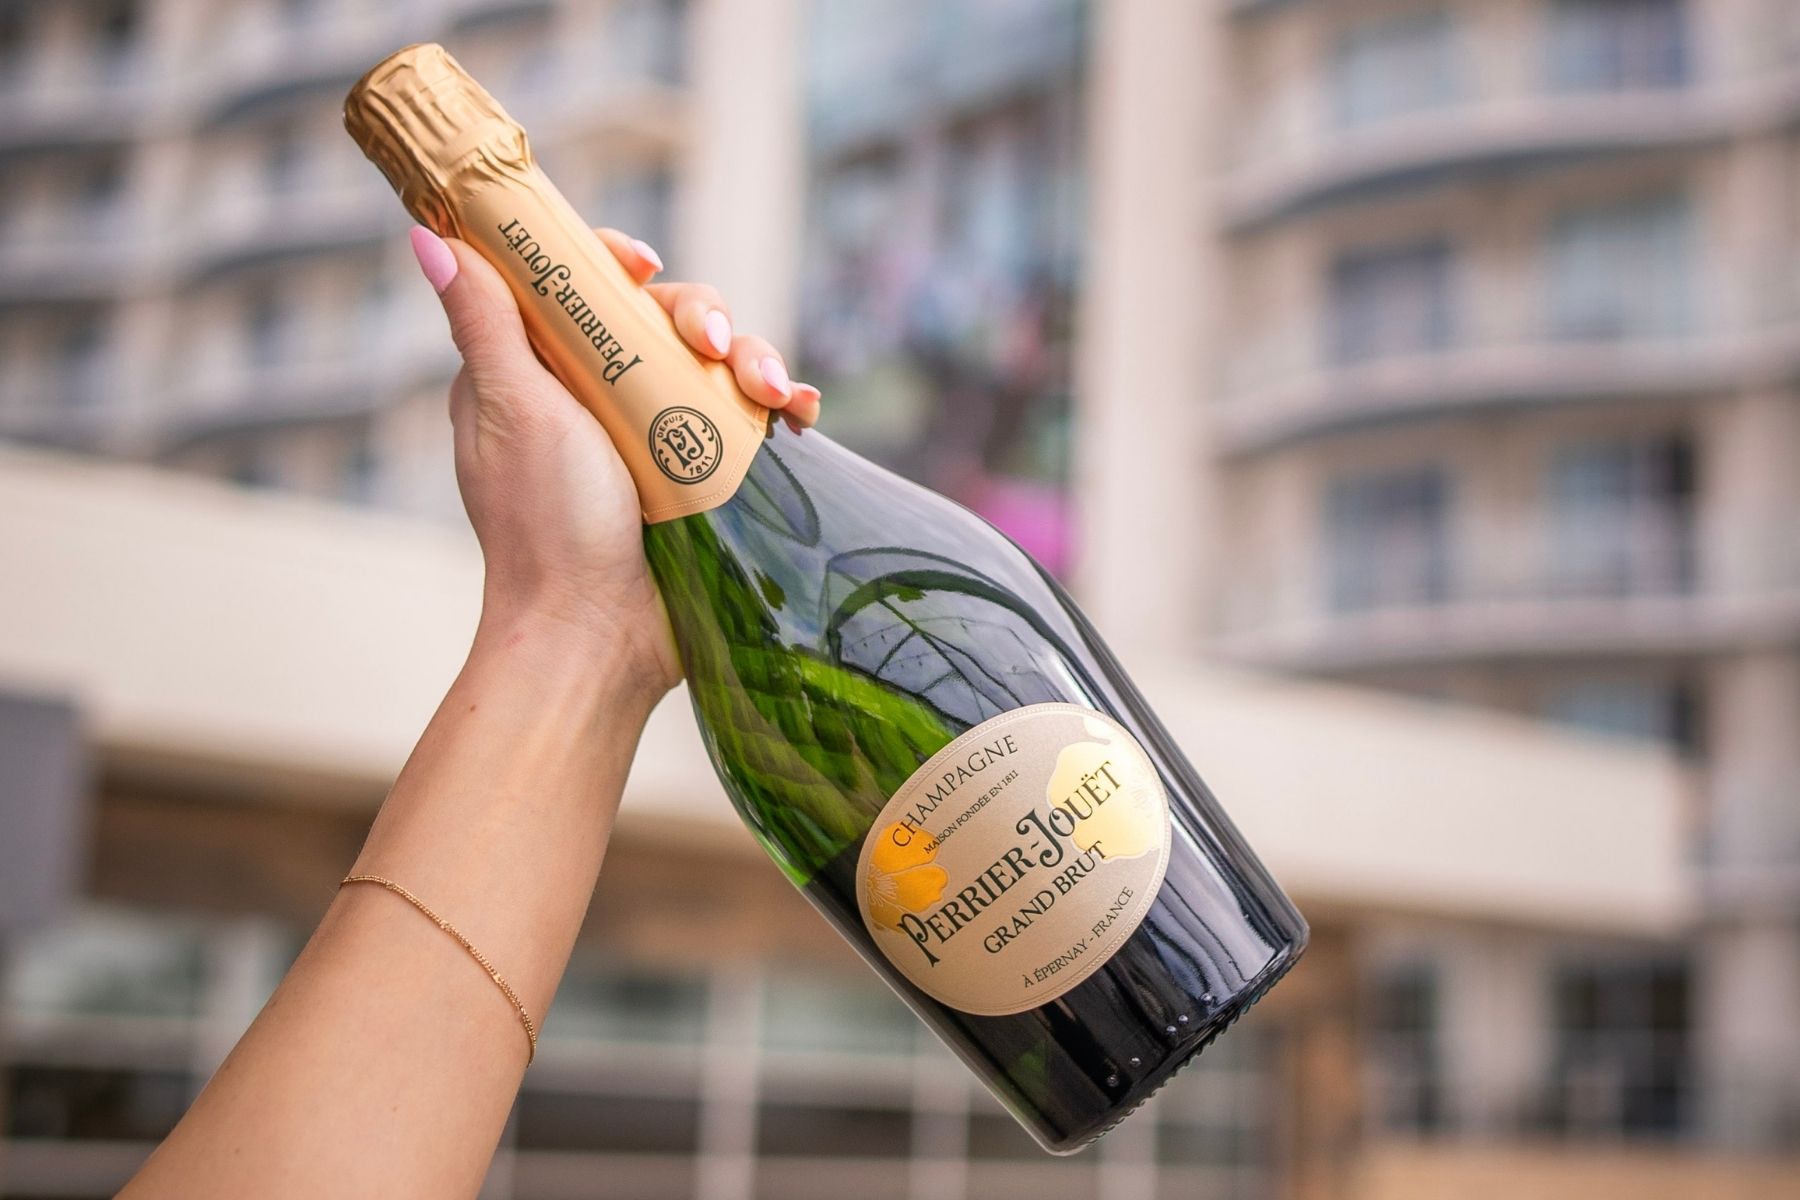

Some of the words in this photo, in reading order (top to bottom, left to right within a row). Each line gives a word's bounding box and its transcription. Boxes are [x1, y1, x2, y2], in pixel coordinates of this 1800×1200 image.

[657, 414, 684, 438] DEPUIS
[689, 455, 713, 476] 1811
[892, 734, 1019, 848] CHAMPAGNE
[923, 823, 958, 854] MAISON
[955, 794, 991, 826] FONDÉE
[988, 783, 1003, 797] EN
[1001, 769, 1019, 786] 1811
[983, 890, 1056, 954] GRAND
[1051, 840, 1107, 896] BRUT
[1022, 974, 1034, 988] À
[1033, 938, 1088, 982] ÉPERNAY
[1091, 886, 1134, 938] FRANCE
